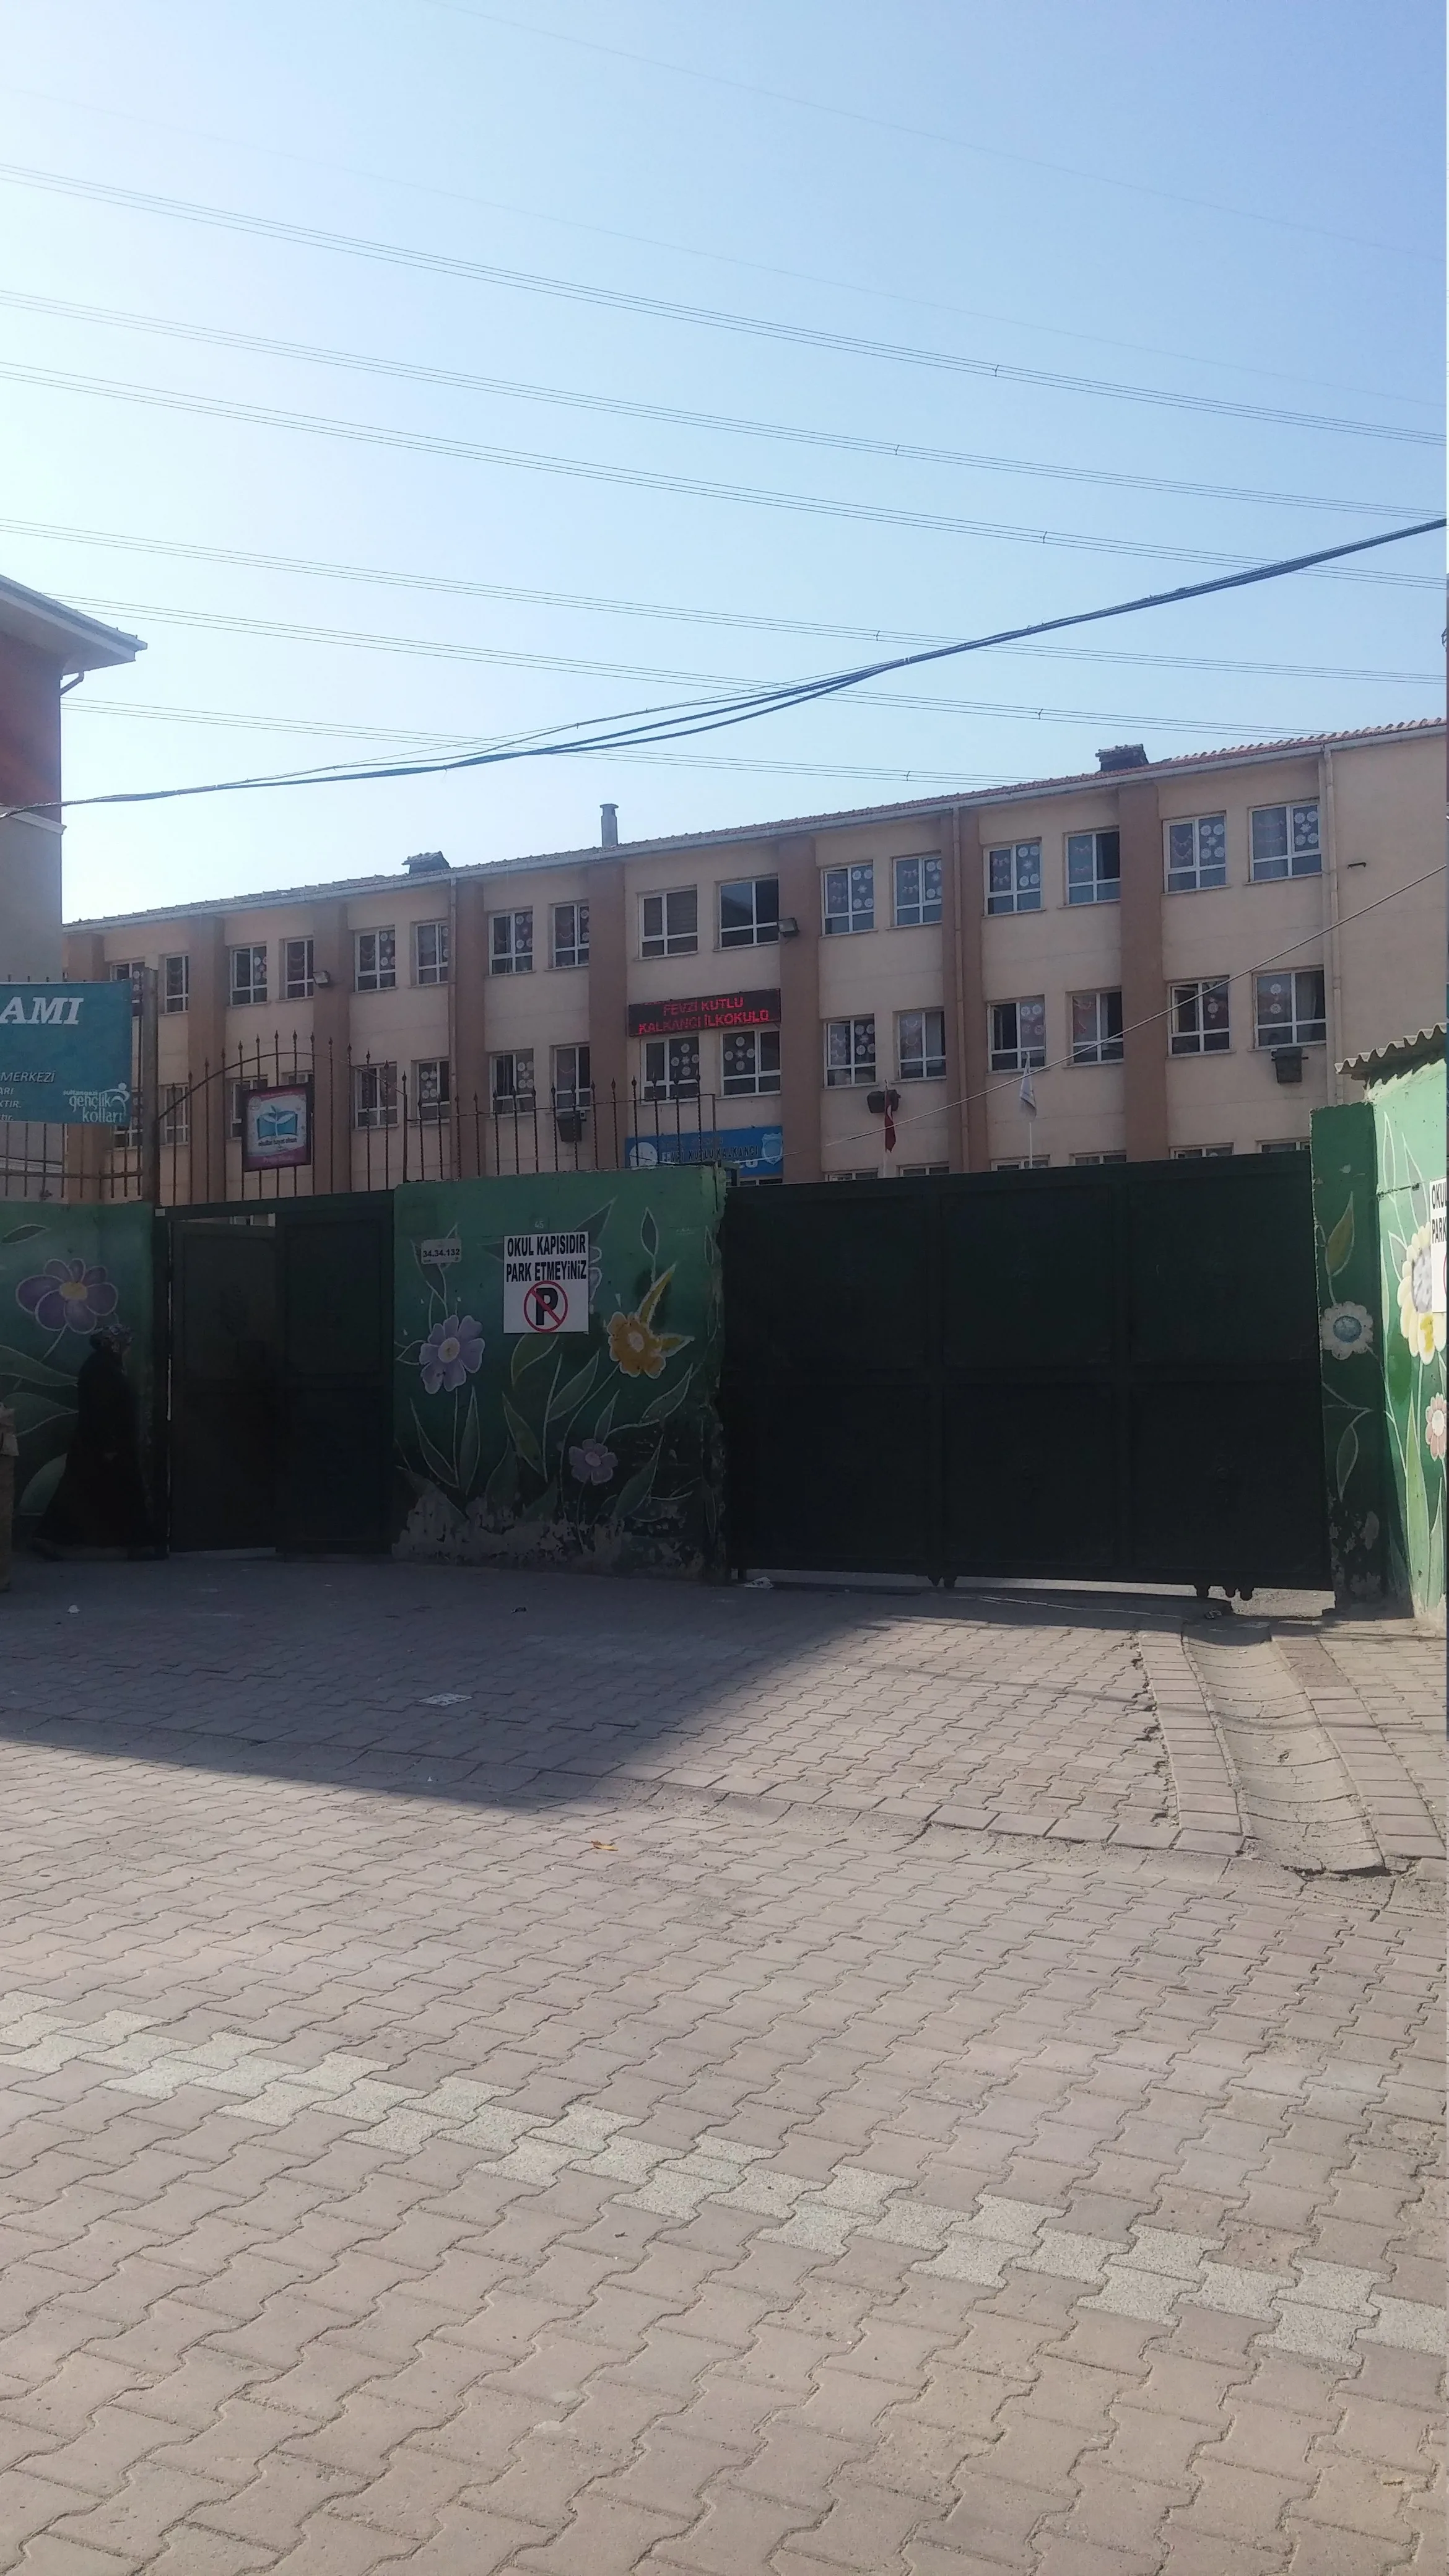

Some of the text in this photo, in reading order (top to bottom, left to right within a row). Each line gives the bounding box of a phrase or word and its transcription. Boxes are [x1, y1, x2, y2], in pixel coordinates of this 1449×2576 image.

[702, 996, 744, 1011] KUTLU
[423, 1248, 460, 1258] 34.34.132
[507, 1234, 586, 1257] OKUL KAPISIDIR
[506, 1263, 532, 1282] PARK
